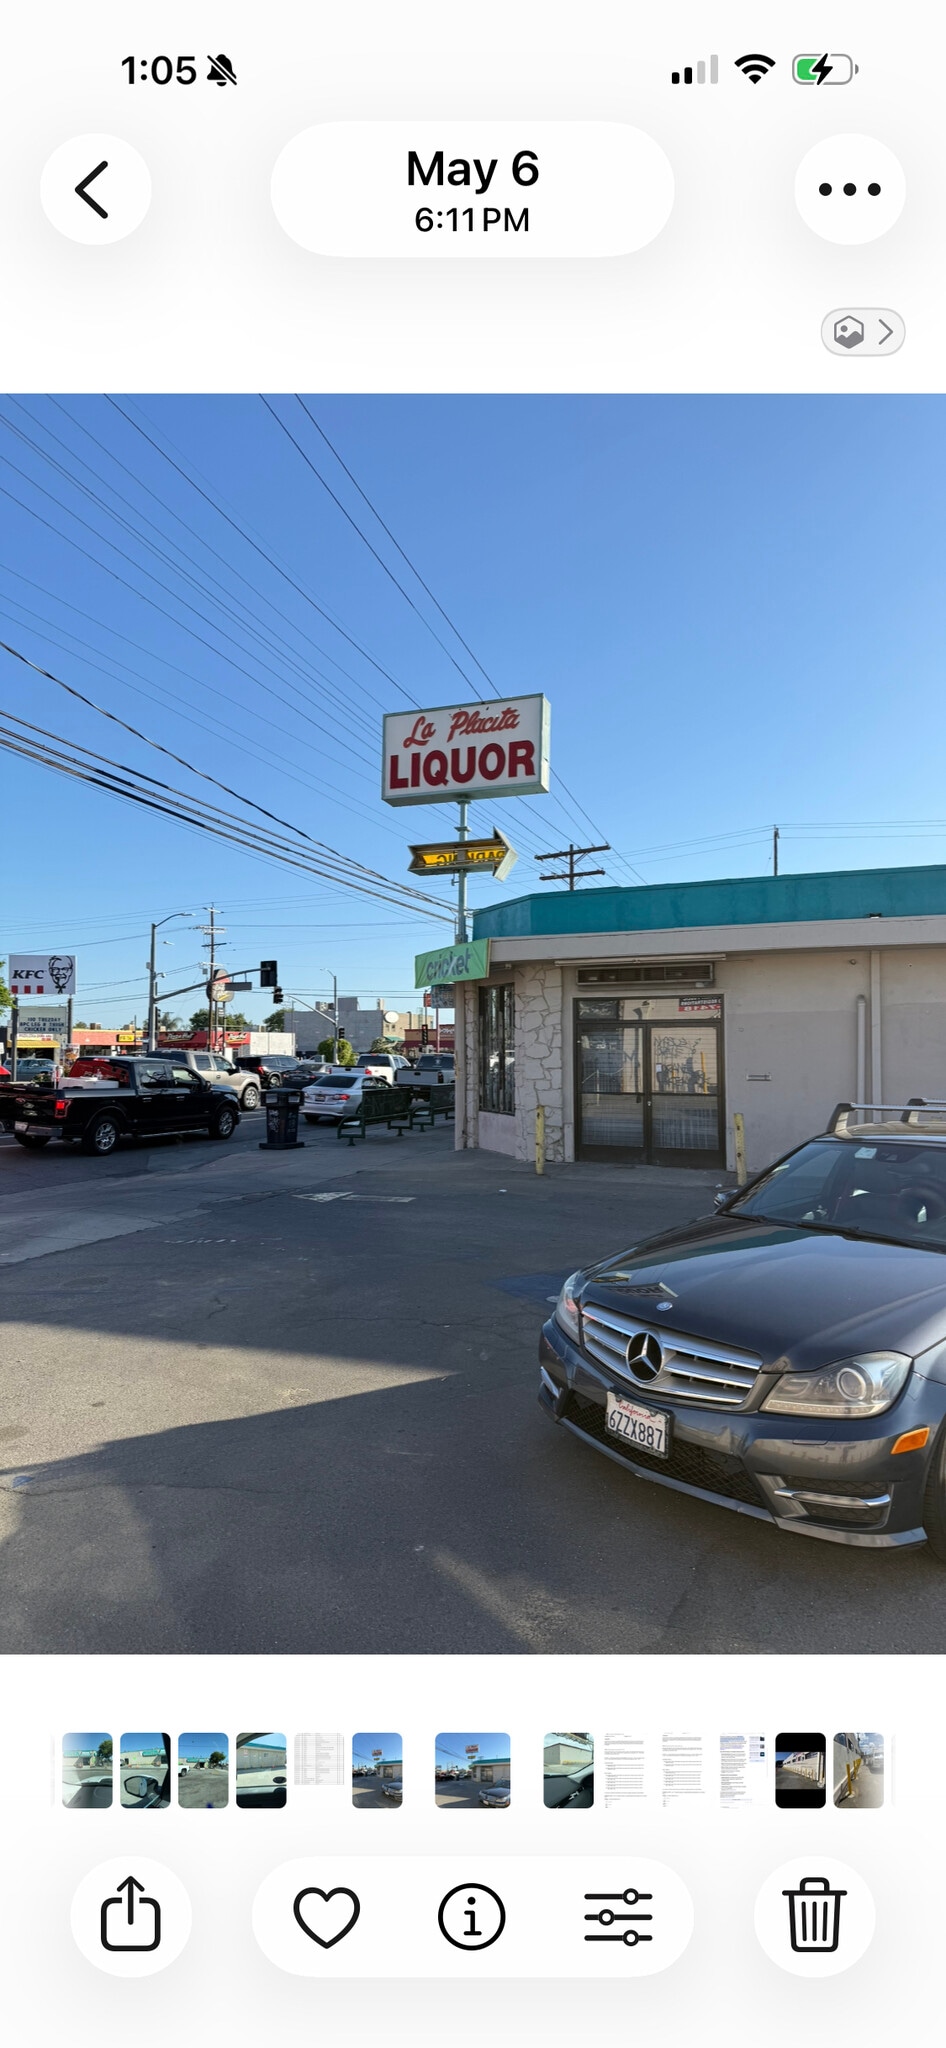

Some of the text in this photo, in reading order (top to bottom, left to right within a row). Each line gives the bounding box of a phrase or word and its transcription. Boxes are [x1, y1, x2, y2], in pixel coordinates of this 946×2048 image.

[403, 707, 521, 749] La Placita
[389, 739, 536, 790] LIQUOR
[12, 970, 45, 980] KFC
[426, 948, 471, 981] cricket
[609, 1409, 663, 1450] 6ZZX887
